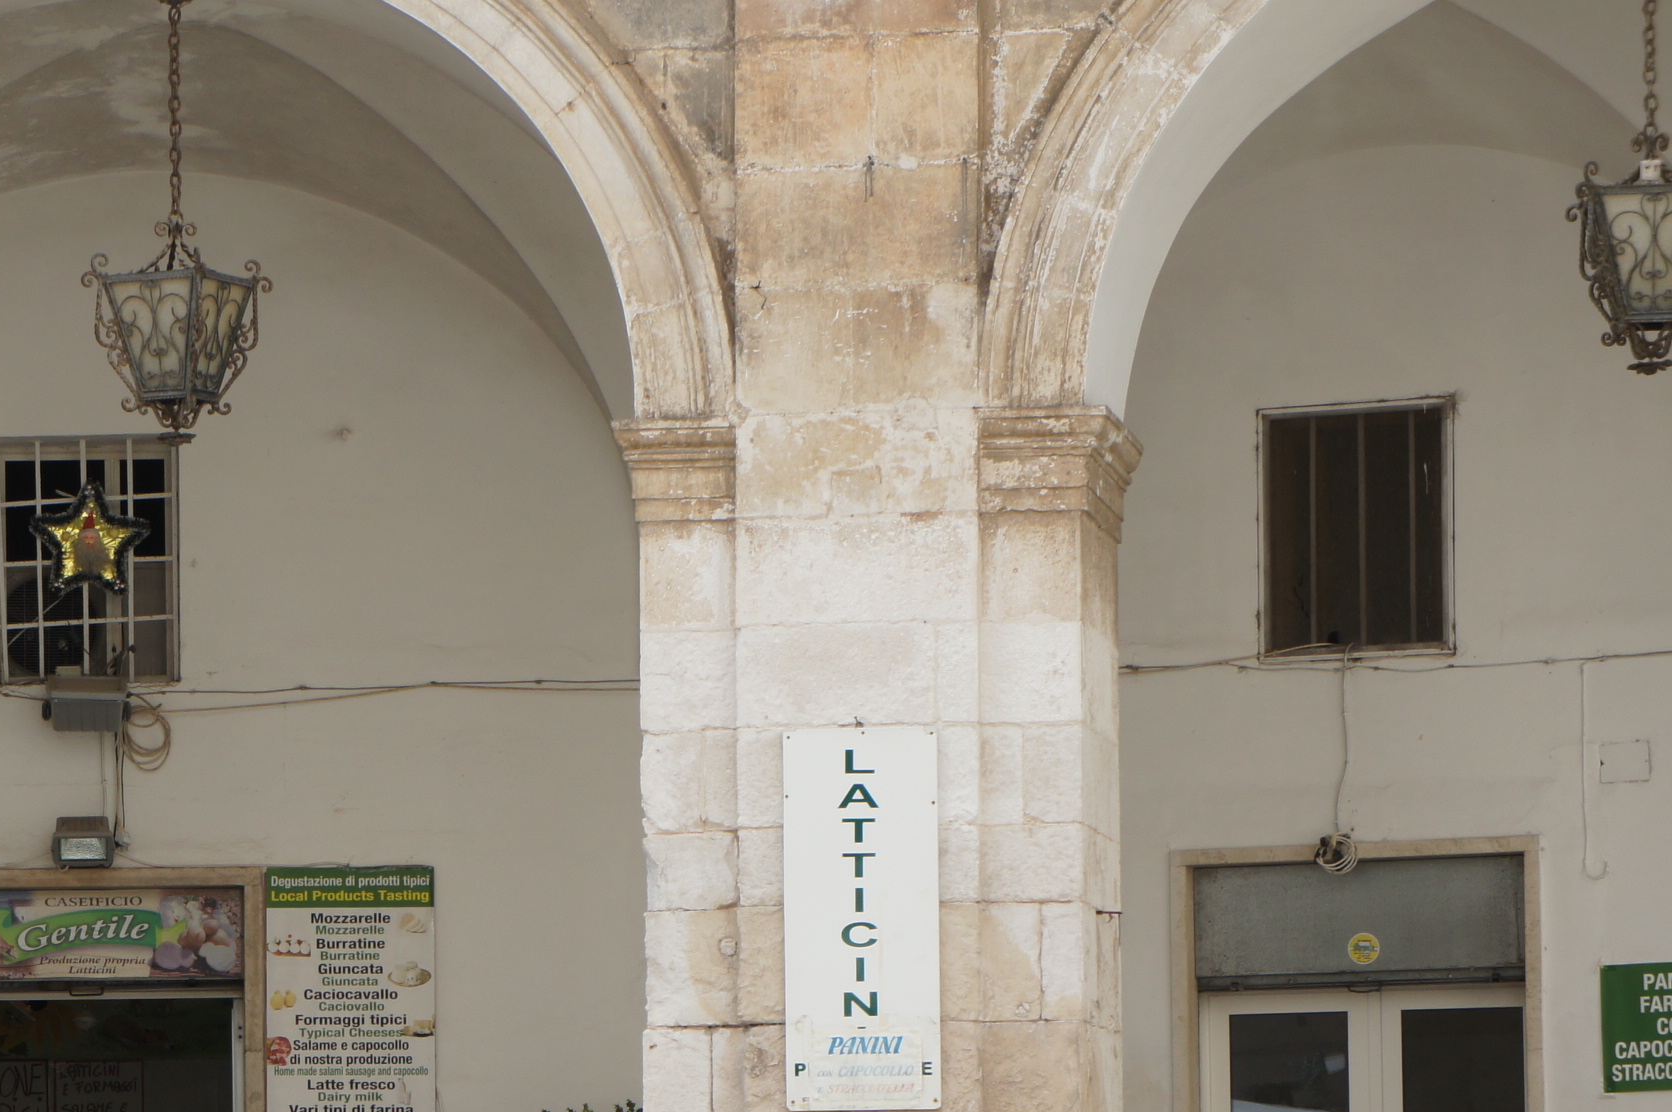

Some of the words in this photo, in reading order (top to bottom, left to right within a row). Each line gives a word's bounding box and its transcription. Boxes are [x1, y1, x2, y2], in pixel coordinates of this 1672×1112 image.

[271, 876, 342, 887] Degustazione
[346, 876, 355, 886] di
[359, 876, 399, 887] prodotti
[403, 875, 429, 886] tipici
[838, 749, 879, 1029] LATTICIN
[45, 896, 142, 907] CASEIFICIO
[271, 891, 307, 901] Local
[312, 891, 374, 901] Products
[378, 890, 429, 903] Tasting
[311, 913, 390, 923] Mozzarelle
[18, 915, 149, 951] Gentile
[316, 926, 384, 935] Mozzarelle
[316, 939, 385, 949] Burratine
[320, 951, 380, 960] Burratine
[40, 956, 101, 966] Produzione
[104, 956, 145, 968] propria
[69, 965, 116, 974] Latticini
[318, 964, 383, 974] Giuncata
[322, 977, 378, 986] Giuncata
[304, 989, 398, 1000] Caciocavallo
[319, 1002, 384, 1011] Caciovallo
[295, 1015, 365, 1027] Formaggi
[371, 1015, 407, 1027] tipici
[300, 1028, 344, 1039] Typical
[349, 1028, 403, 1037] Cheeses
[293, 1040, 337, 1051] Salame
[341, 1042, 348, 1051] e
[352, 1040, 409, 1052] capocollo
[828, 1036, 904, 1055] PANINI
[290, 1054, 300, 1064] di
[305, 1055, 342, 1064] nostra
[346, 1054, 412, 1066] produzione
[274, 1066, 295, 1075] Home
[297, 1066, 317, 1075] made
[319, 1066, 343, 1075] salami
[345, 1068, 375, 1077] sausage
[378, 1066, 391, 1075] and
[394, 1066, 428, 1077] capocollo
[838, 1065, 915, 1077] CAPOCOLLO
[307, 1079, 344, 1090] Latte
[350, 1079, 395, 1090] fresco
[318, 1092, 350, 1103] Dairy
[355, 1092, 383, 1101] milk
